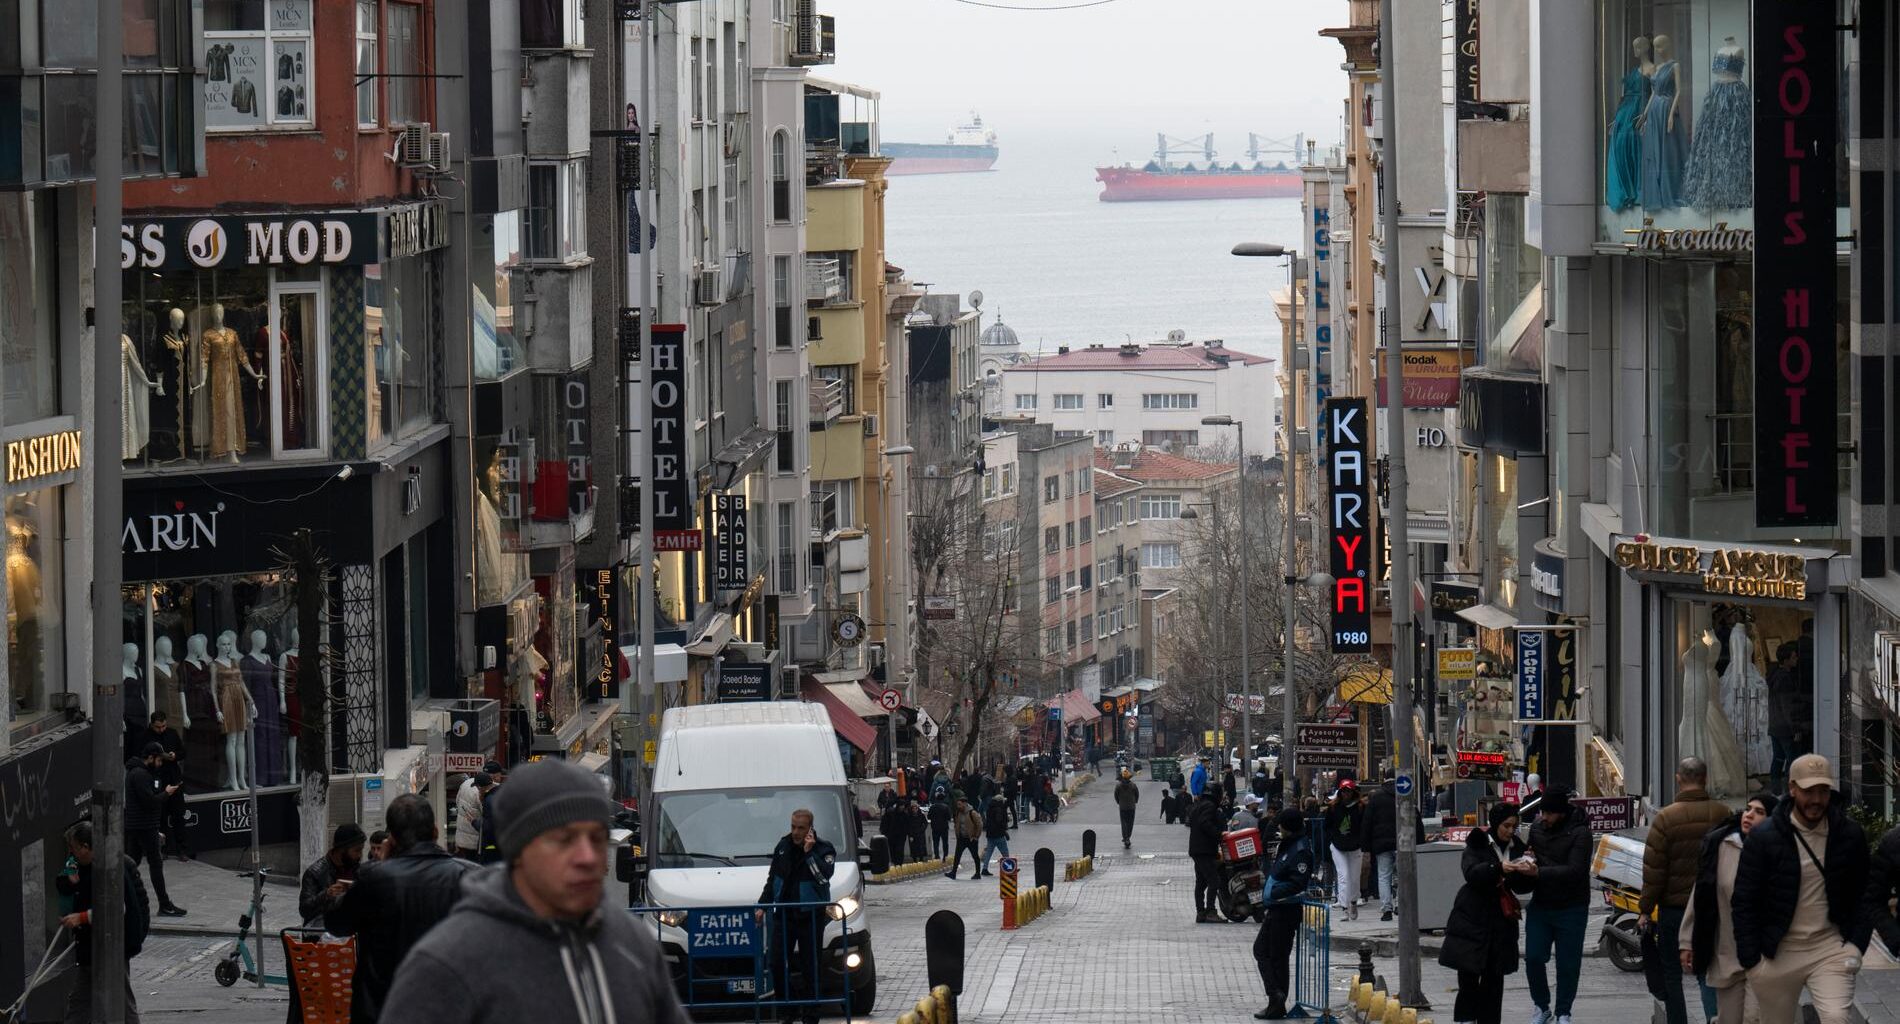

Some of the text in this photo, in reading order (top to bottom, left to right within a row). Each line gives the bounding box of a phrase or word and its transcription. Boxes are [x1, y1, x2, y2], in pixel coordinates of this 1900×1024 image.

[247, 220, 352, 265] MOD
[1778, 25, 1813, 515] SOLIS HOTEL
[1404, 355, 1437, 365] Kodak
[651, 344, 679, 517] HOTEL
[7, 431, 82, 483] FASHION
[1333, 408, 1365, 613] KARYA
[718, 497, 728, 579] SAEED
[734, 497, 744, 580] BADER
[1335, 631, 1368, 645] 1980
[1440, 652, 1473, 662] FOTO
[1523, 650, 1538, 718] PORTHALL
[1308, 729, 1344, 737] Ayasofya
[448, 756, 483, 767] NOTER
[1308, 755, 1356, 764] Sultanahmet
[1589, 819, 1627, 830] FFEUR
